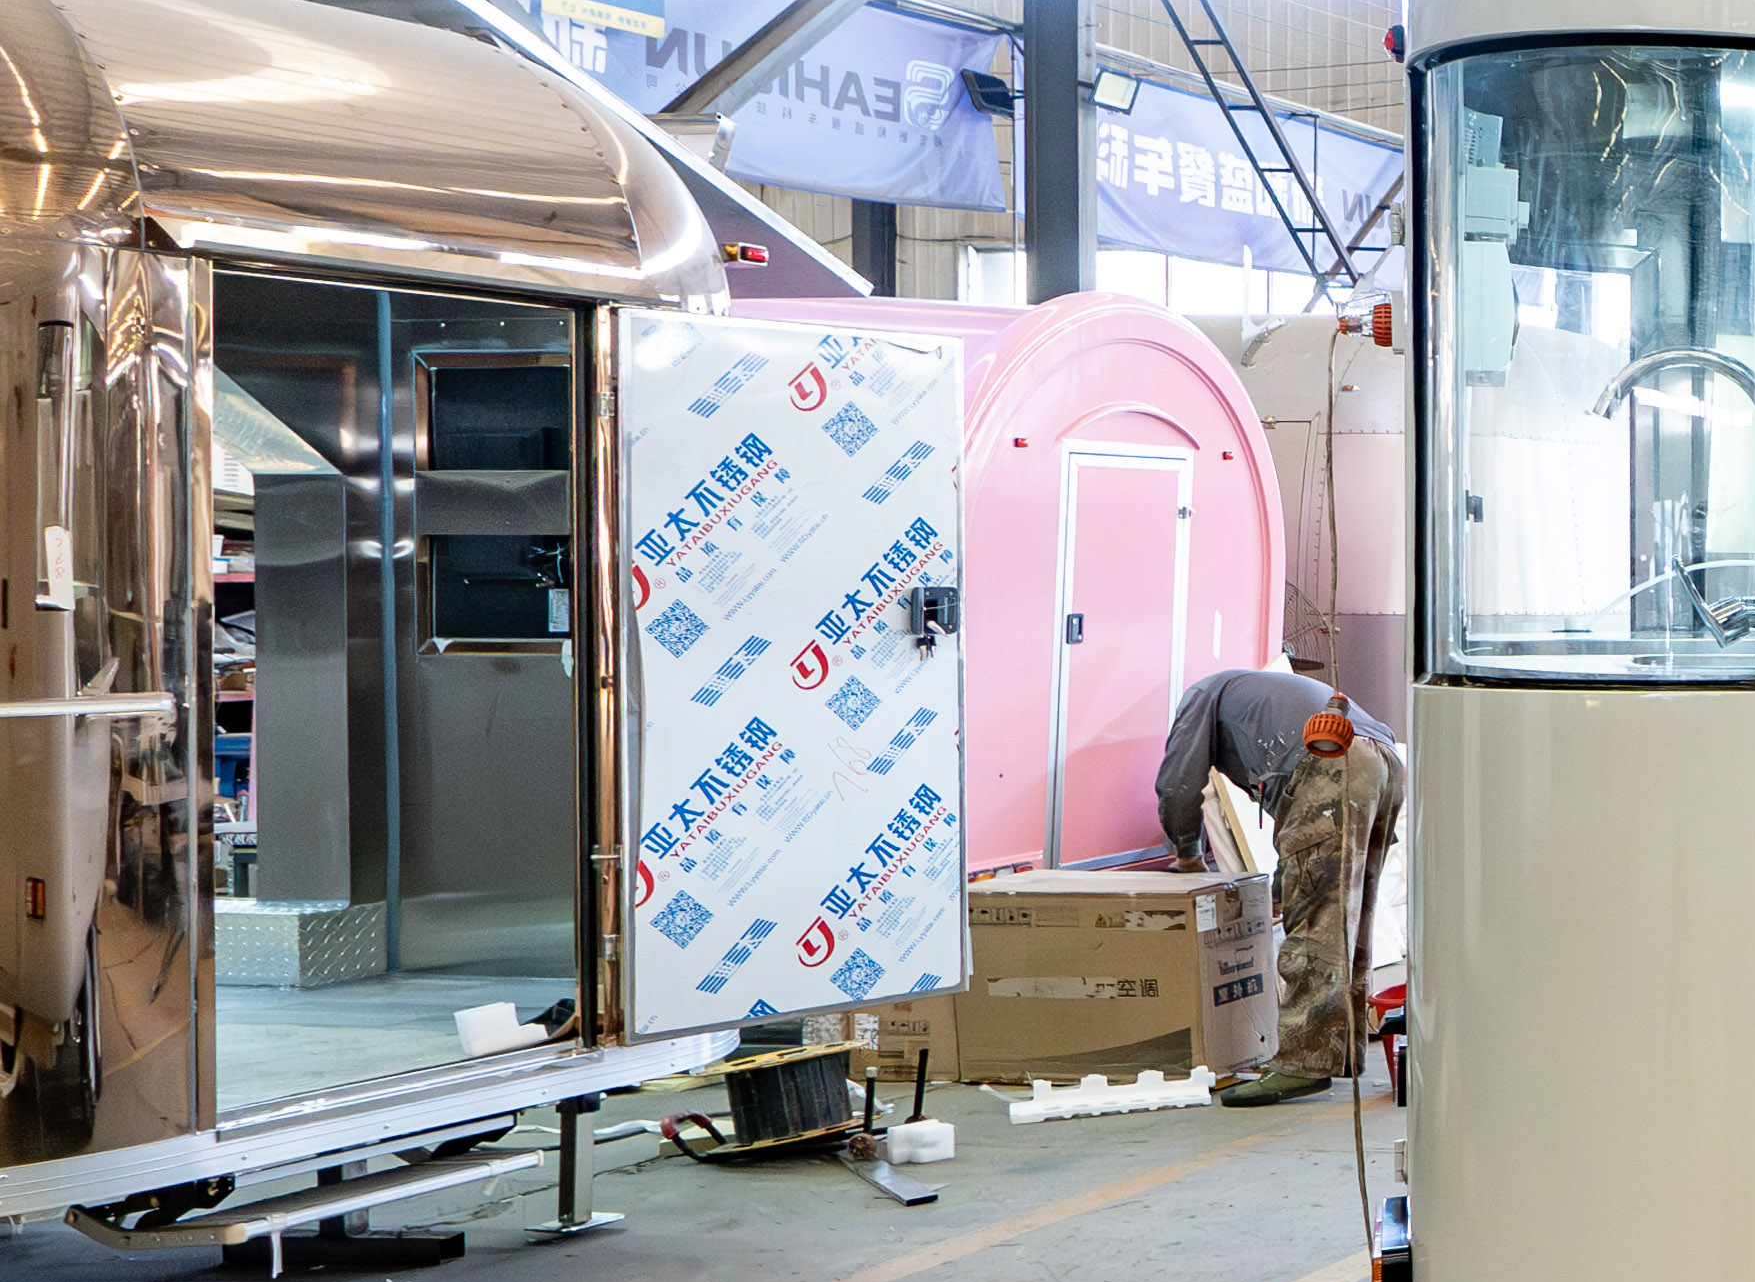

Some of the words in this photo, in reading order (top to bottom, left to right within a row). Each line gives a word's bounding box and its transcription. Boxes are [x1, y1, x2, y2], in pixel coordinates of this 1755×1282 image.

[634, 431, 773, 567] 亚太不锈钢
[665, 459, 779, 568] YATAIBUXIUGANG
[815, 516, 940, 647] 亚太不锈钢
[842, 540, 945, 648] YATAIBUXIUGANG
[639, 716, 779, 861] 亚太不锈钢
[668, 740, 784, 860] YATAIBUXIUGANG
[820, 783, 943, 921] 亚太不锈钢
[848, 805, 948, 921] YATAIBUXIUGANG
